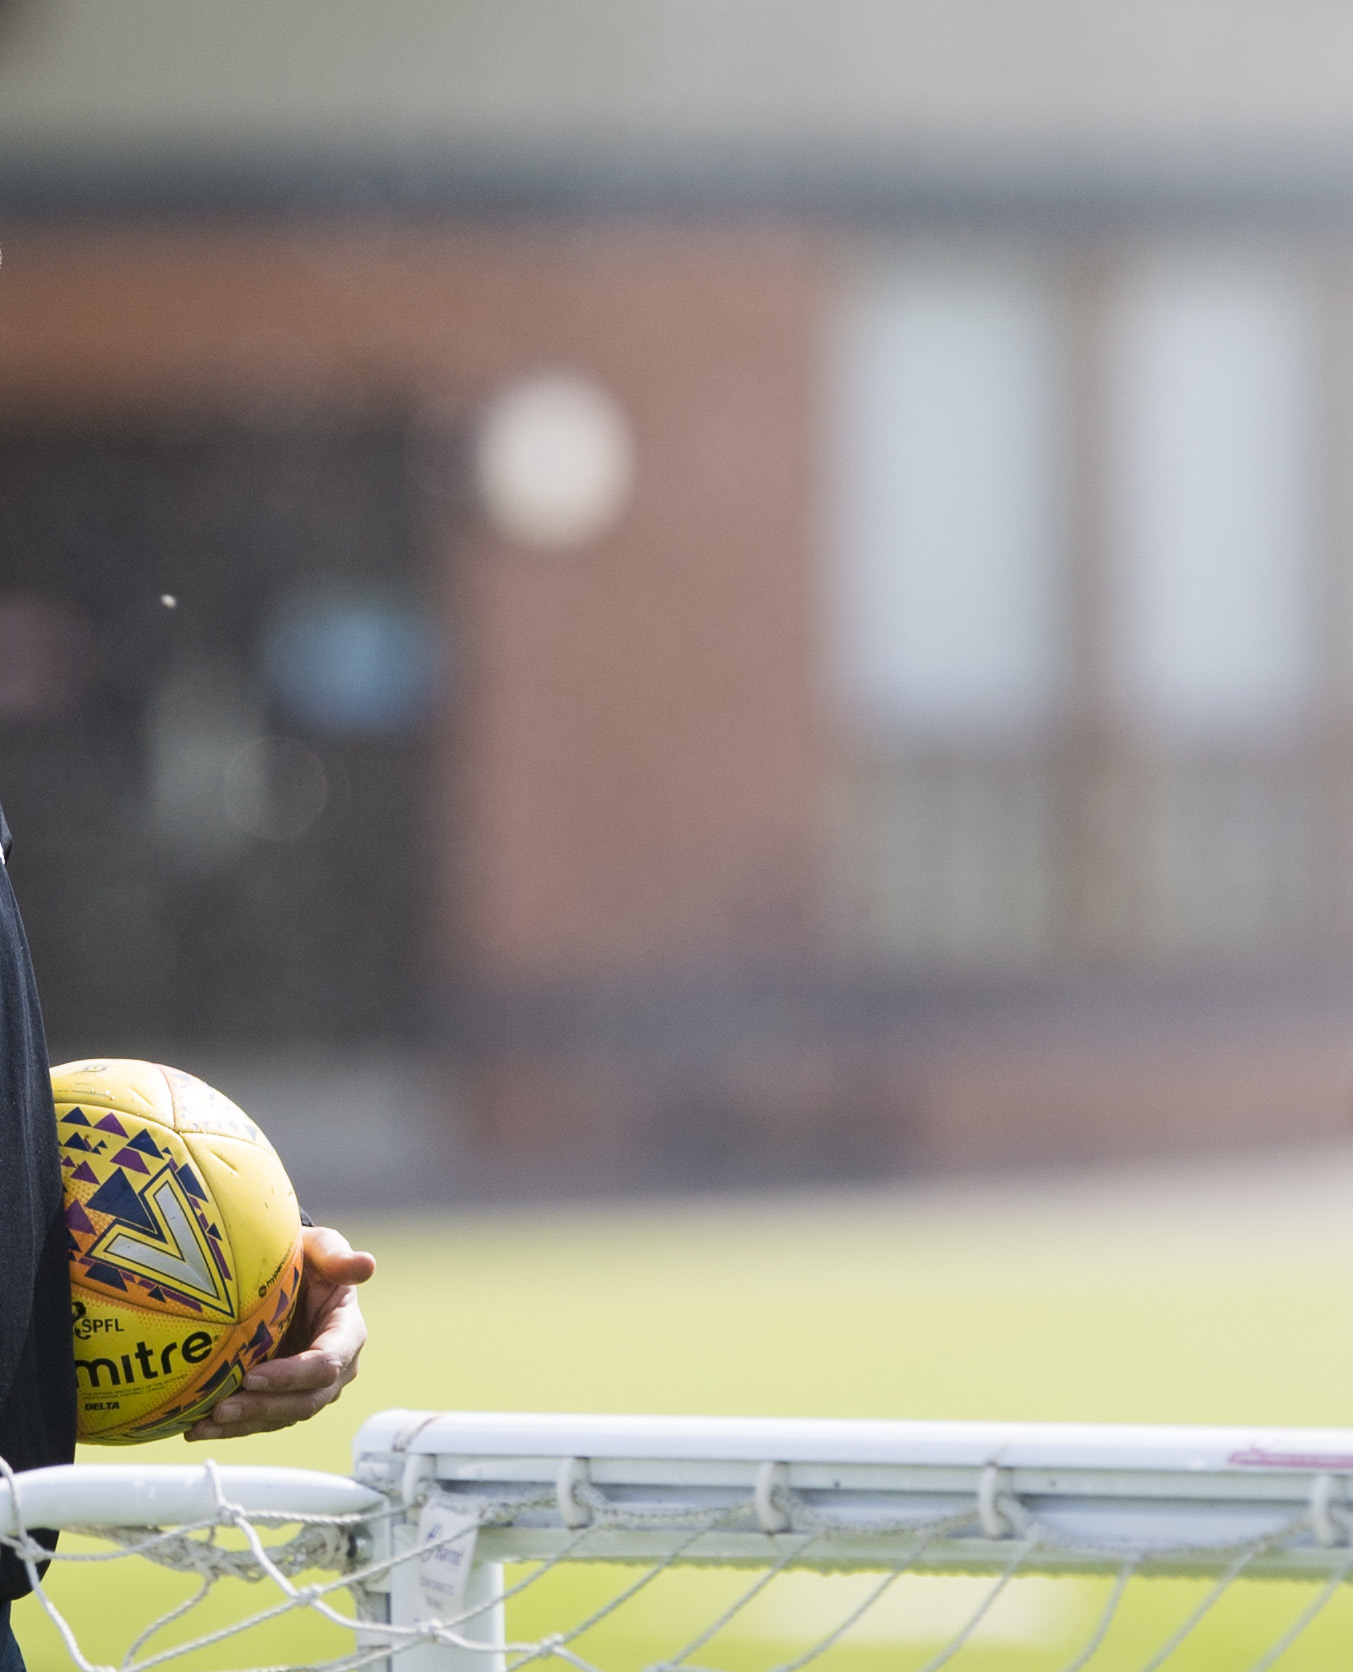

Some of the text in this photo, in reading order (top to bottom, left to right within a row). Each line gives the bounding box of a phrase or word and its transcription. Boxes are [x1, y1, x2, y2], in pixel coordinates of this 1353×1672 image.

[81, 1318, 125, 1333] SPFL
[75, 1331, 213, 1388] mitre
[84, 1401, 120, 1411] DELTA
